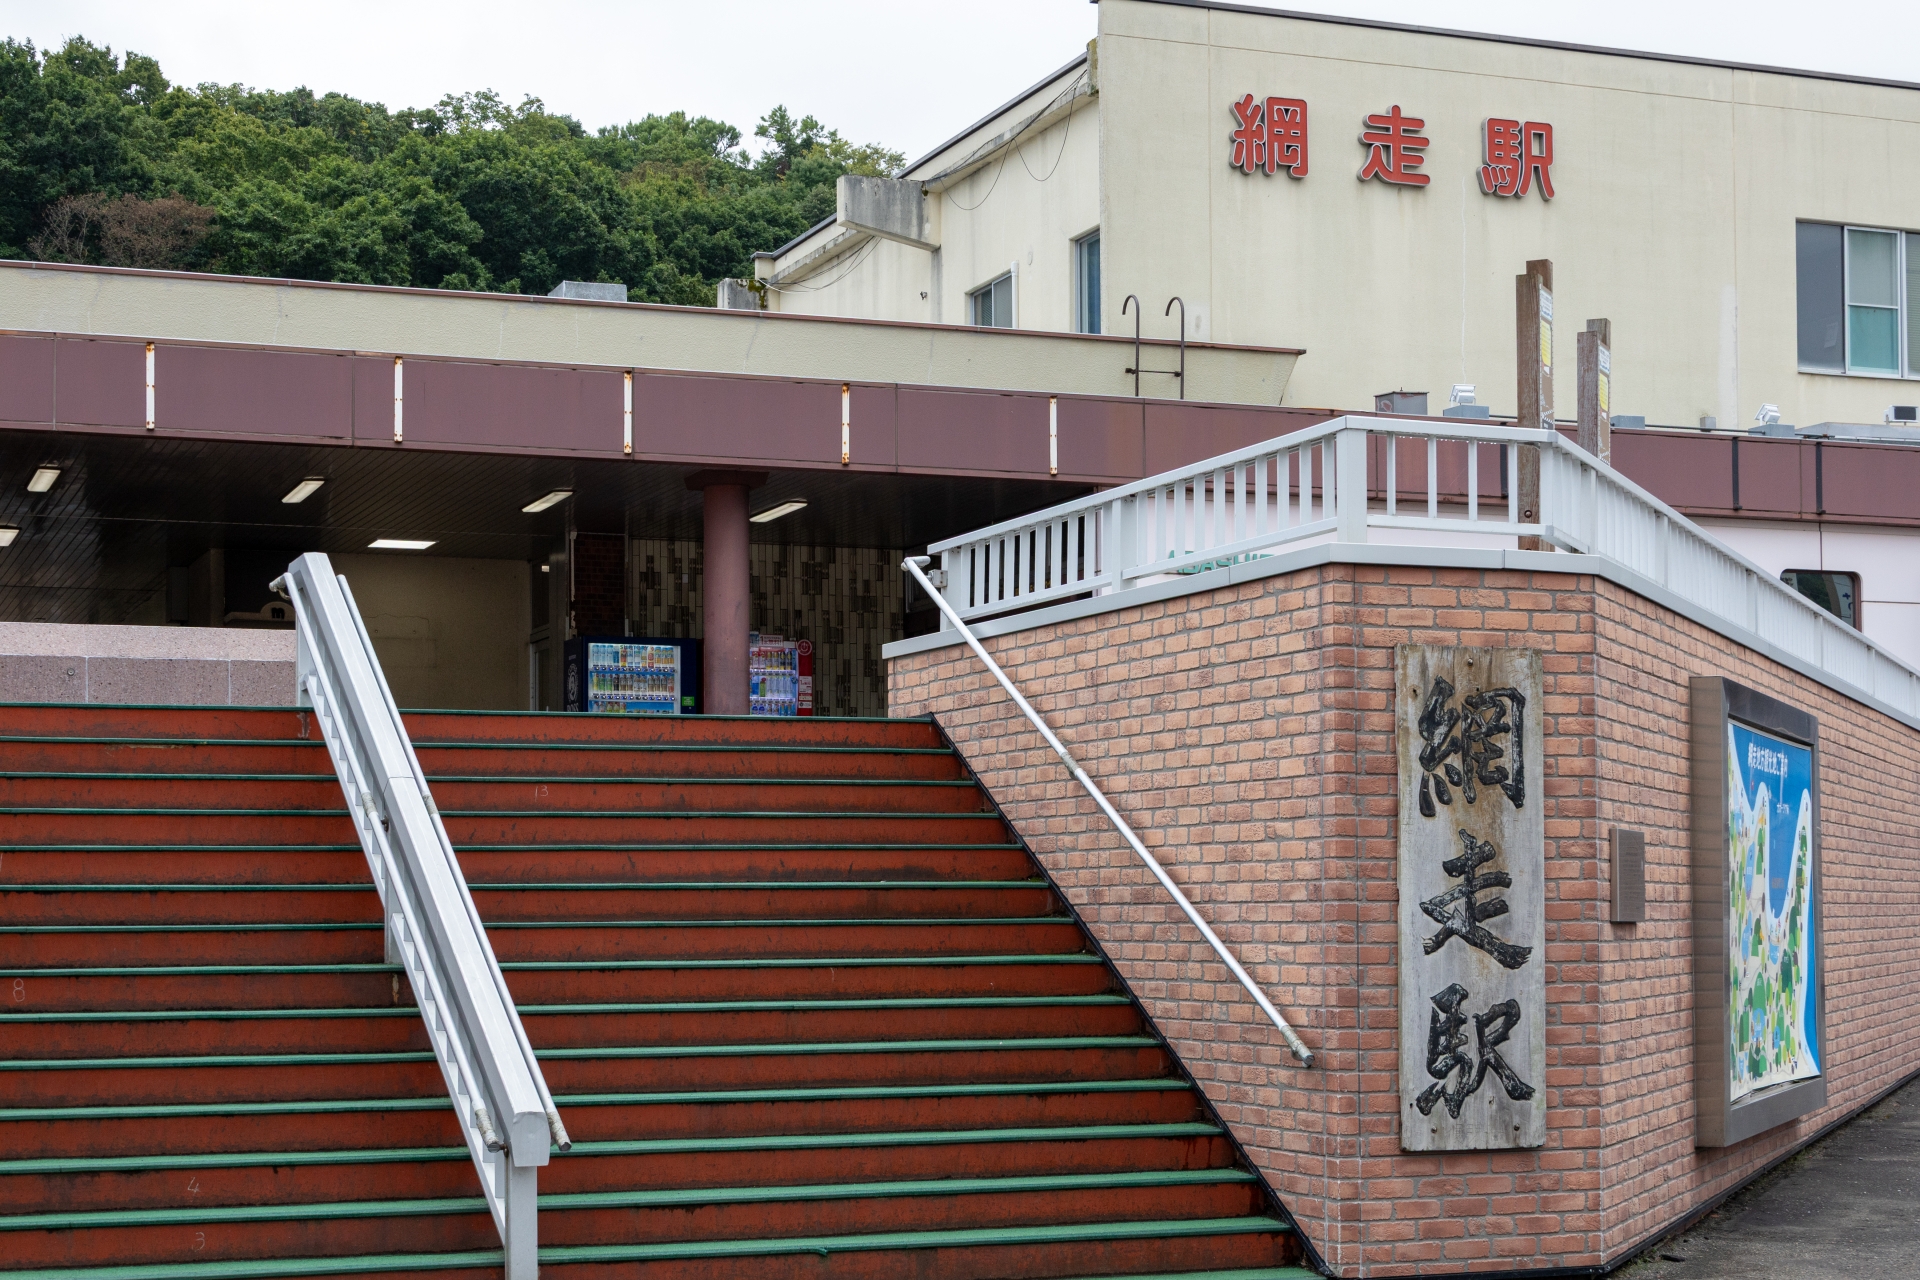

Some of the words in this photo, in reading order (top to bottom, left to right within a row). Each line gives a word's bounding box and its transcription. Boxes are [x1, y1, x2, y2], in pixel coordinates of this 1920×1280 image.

[1228, 92, 1556, 202] 網走駅
[1414, 674, 1537, 1120] 網走駅
[12, 977, 26, 1003] 8
[191, 1231, 206, 1253] 3
